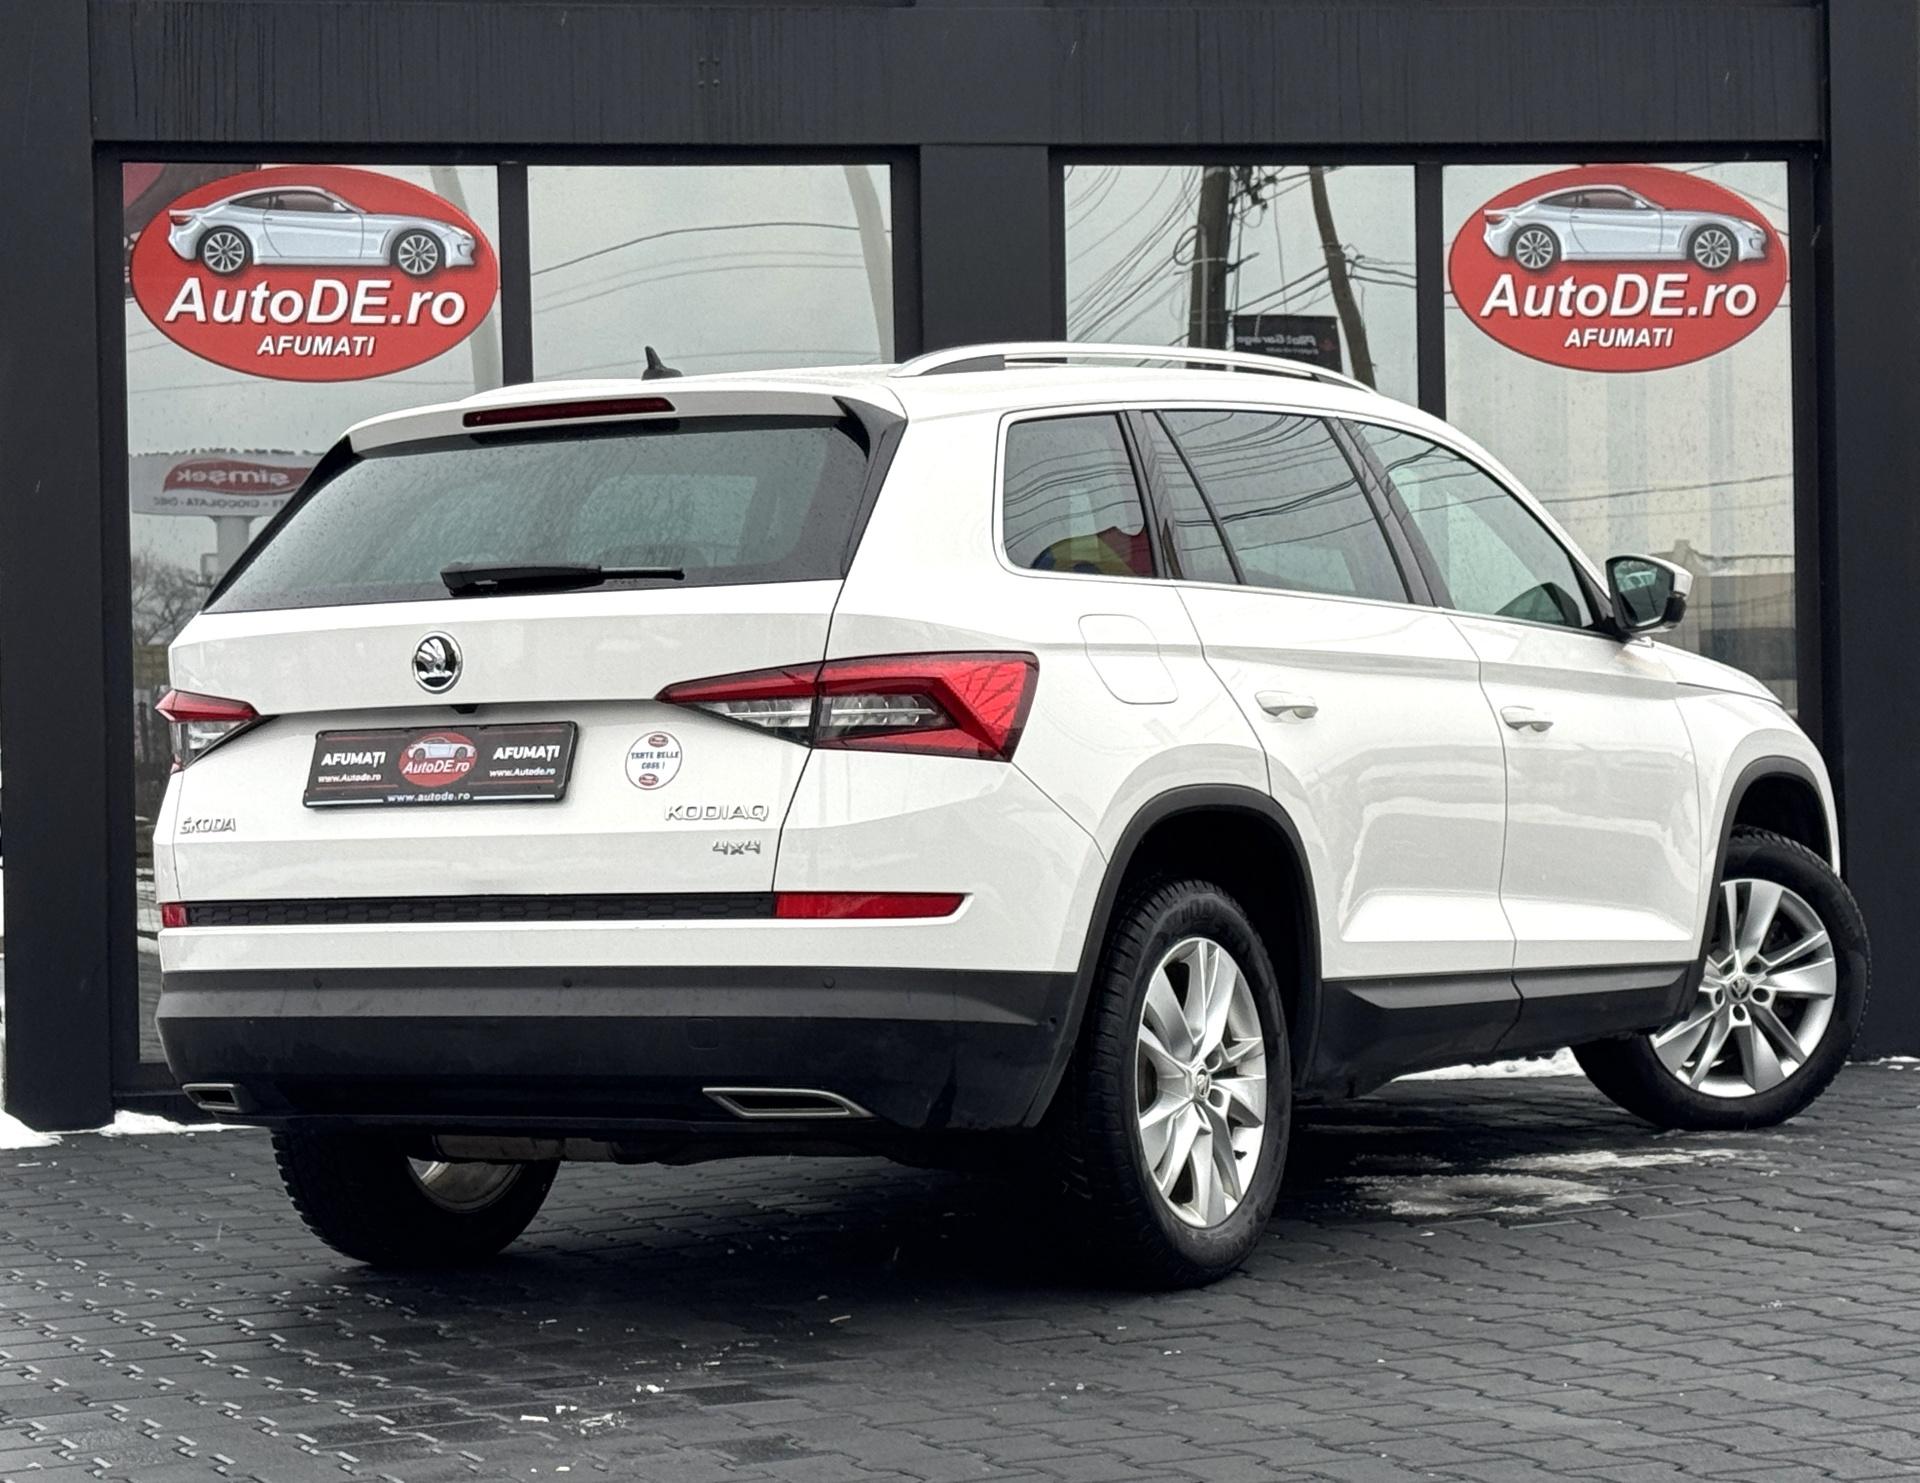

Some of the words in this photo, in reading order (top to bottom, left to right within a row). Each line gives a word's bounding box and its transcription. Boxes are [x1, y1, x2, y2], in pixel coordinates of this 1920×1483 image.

[164, 277, 466, 326] AutoDE.ro
[1480, 273, 1757, 318] AutoDE.ro
[257, 336, 376, 357] AFUMATI
[1564, 328, 1674, 348] AFUMATI
[402, 759, 470, 774] AutoDE.ro
[388, 791, 471, 802] www.autode.ro
[665, 805, 769, 821] KODIAQ
[712, 840, 761, 855] 4x4
